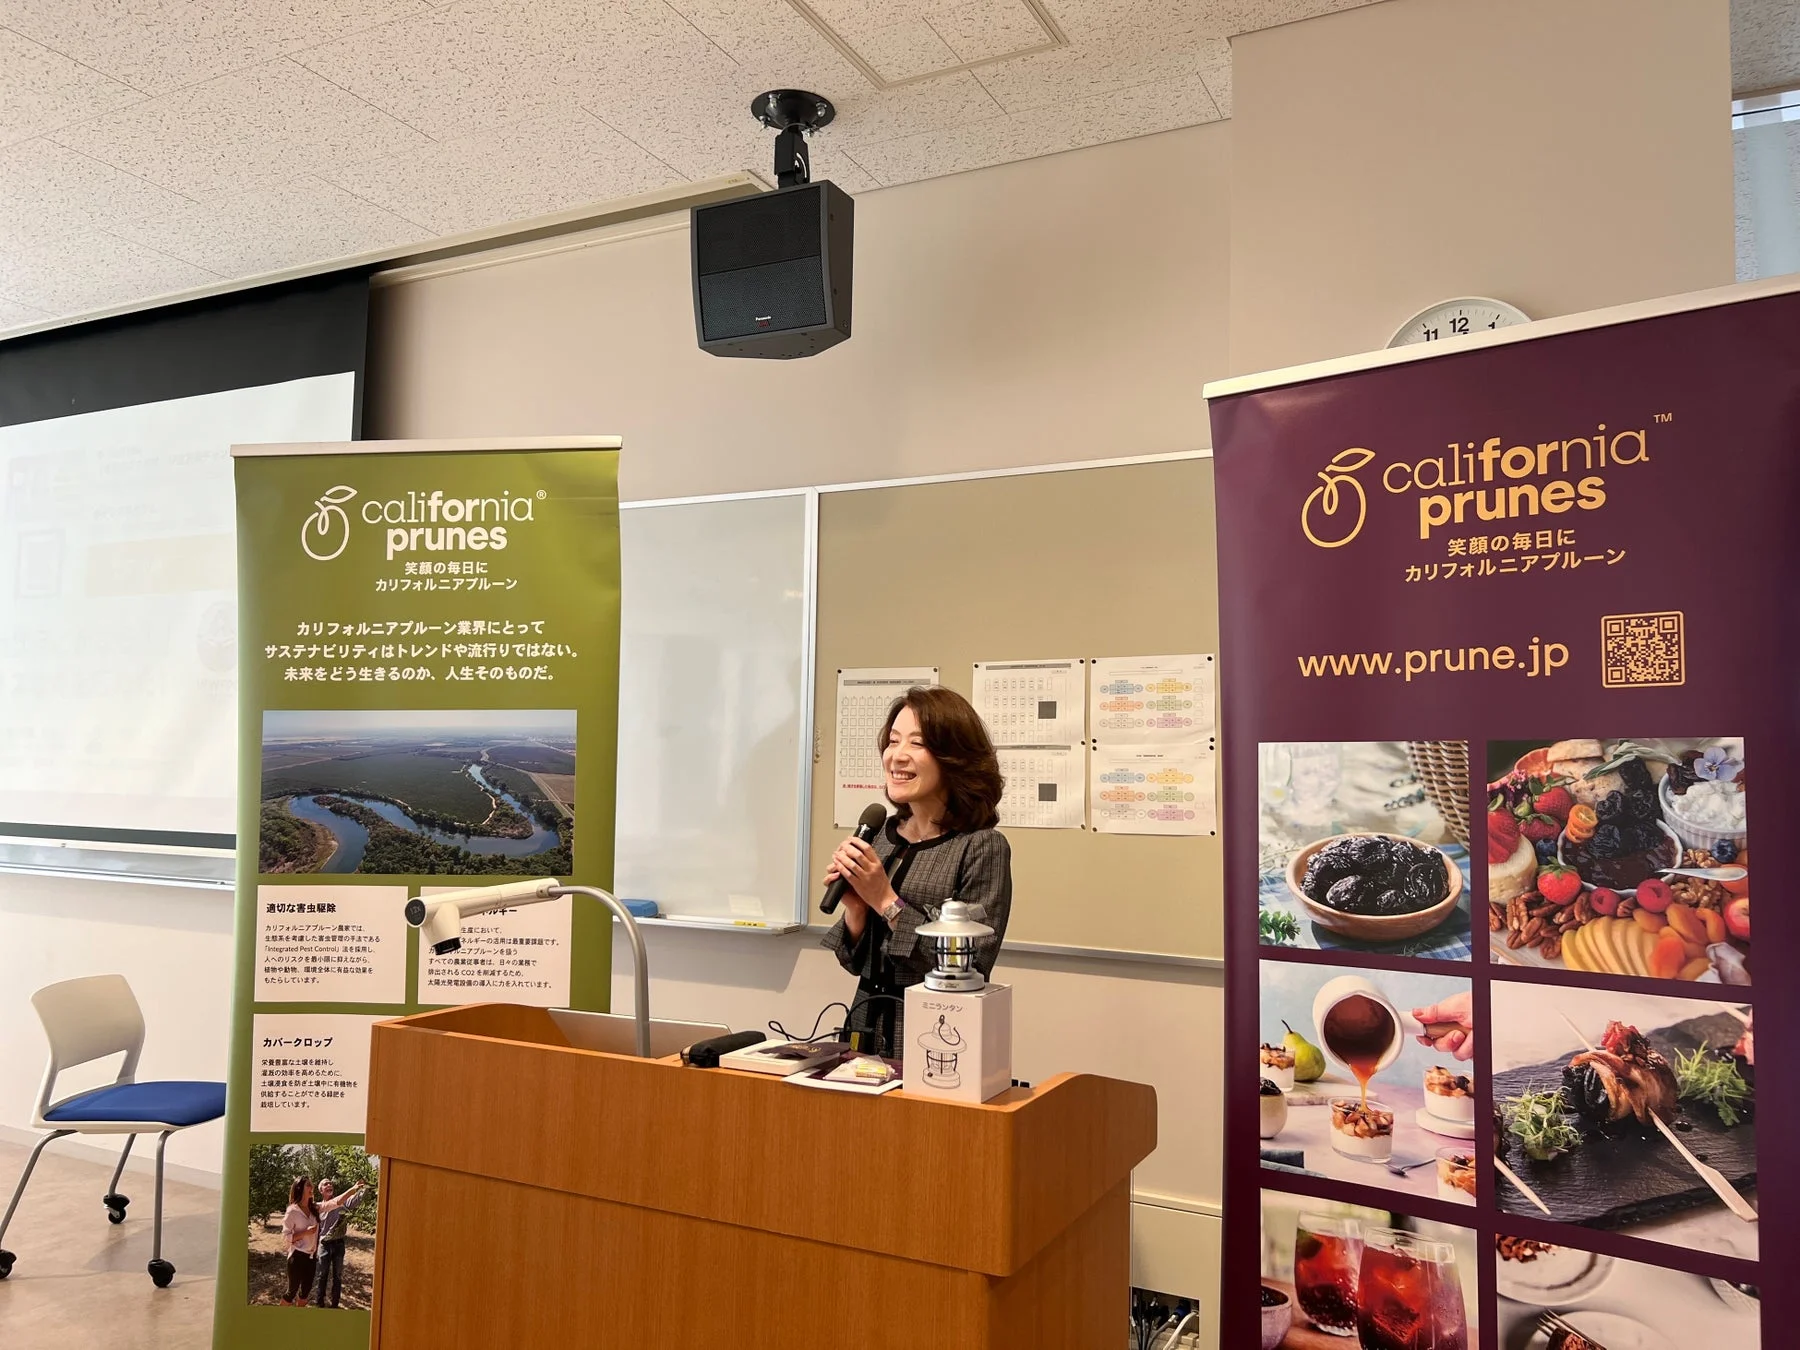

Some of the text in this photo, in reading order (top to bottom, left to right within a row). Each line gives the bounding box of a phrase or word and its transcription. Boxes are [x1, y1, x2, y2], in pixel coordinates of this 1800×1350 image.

[1449, 317, 1469, 333] 12
[1382, 424, 1650, 494] california
[361, 490, 534, 524] california
[1419, 475, 1607, 539] prunes
[386, 526, 508, 561] prunes
[1446, 528, 1576, 556] 笑顔の毎日に
[404, 561, 488, 575] 笑顔の毎日に
[1404, 548, 1627, 583] カリフォルニアプルーン
[375, 577, 518, 592] カリフォルニアプルーン
[296, 620, 546, 636] カリフォルニアプルーン業界にとって
[264, 642, 578, 659] サステナビリティはトレンドや流行りではない。
[1297, 636, 1569, 682] www.prune.jp
[284, 665, 555, 682] 未来をどう生きるのか、人生そのものだ。
[266, 903, 337, 914] 適切な害虫駆除
[264, 976, 320, 984] もたらしています。
[921, 1001, 963, 1012] ミニランタン
[263, 1037, 333, 1048] カバークロップ
